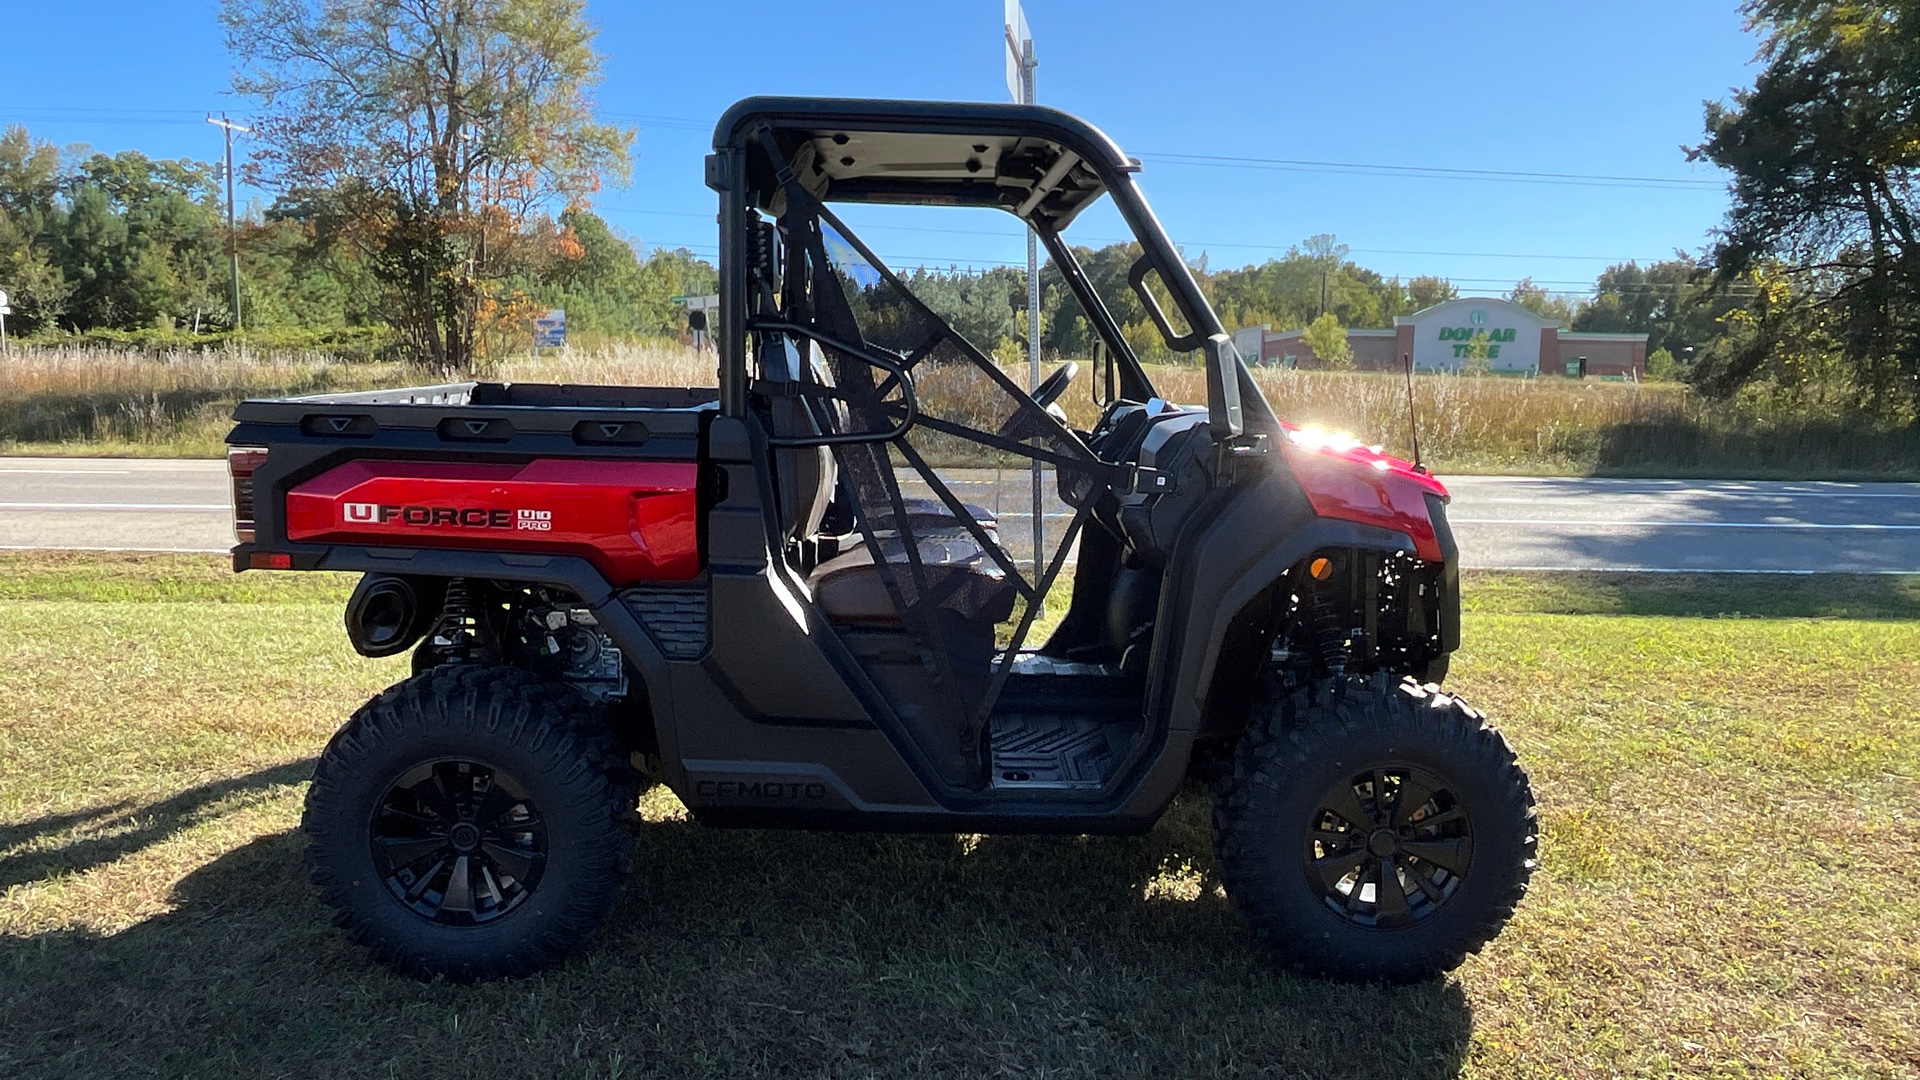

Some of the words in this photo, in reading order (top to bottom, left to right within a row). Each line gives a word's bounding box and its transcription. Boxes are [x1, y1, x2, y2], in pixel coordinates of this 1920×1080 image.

[1453, 344, 1501, 358] TE
[518, 510, 551, 520] U10
[518, 520, 551, 530] PRO
[696, 781, 826, 799] CFMOTO
